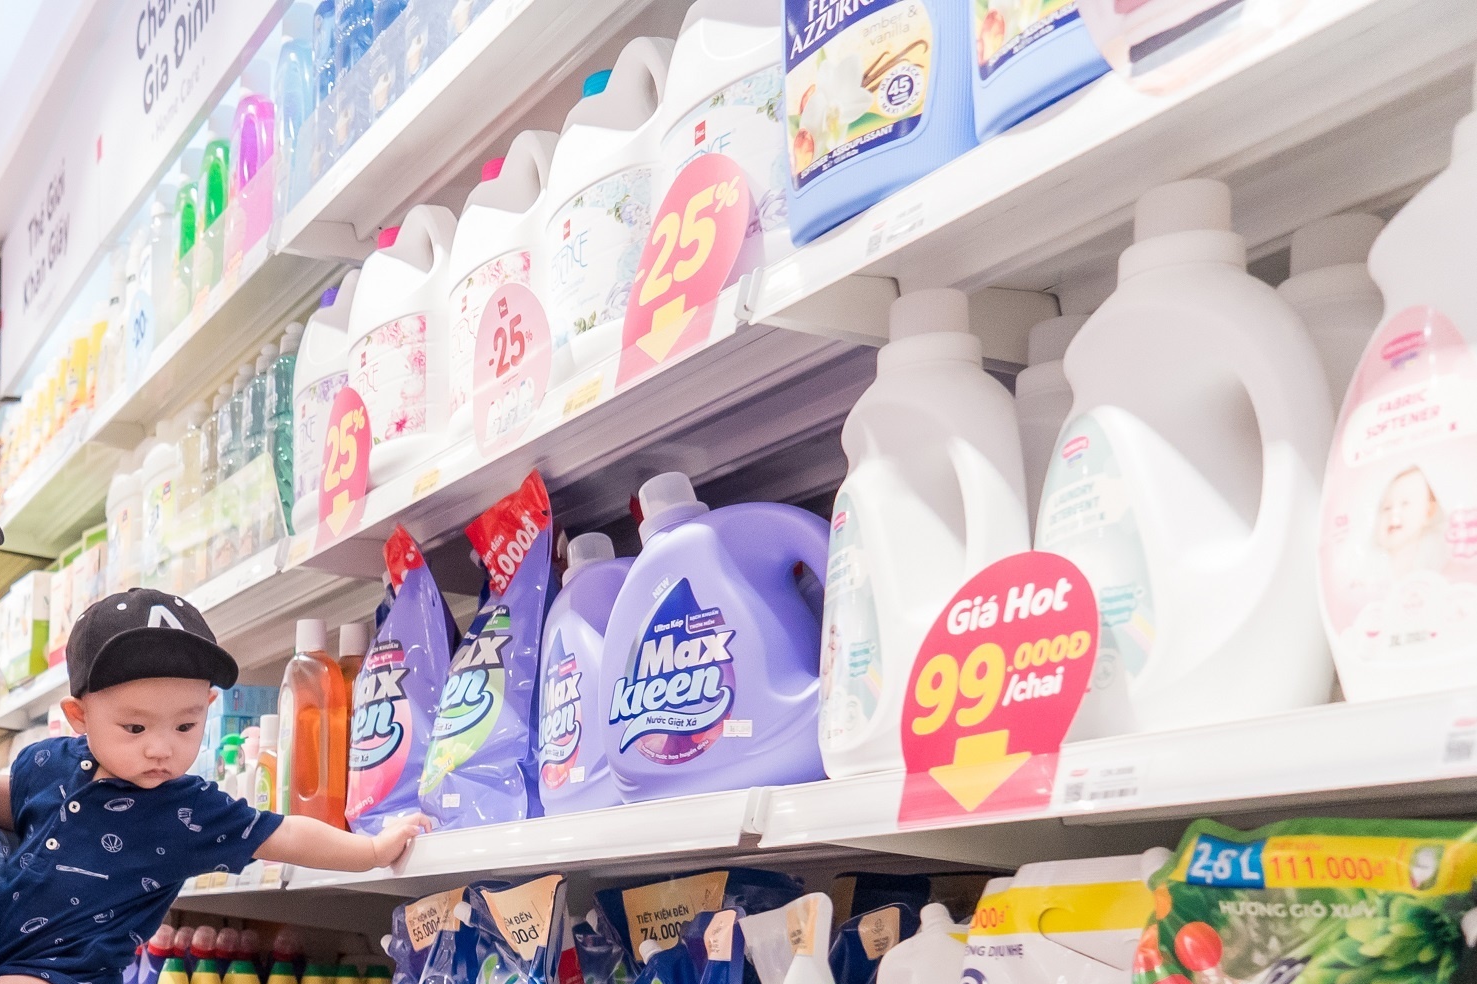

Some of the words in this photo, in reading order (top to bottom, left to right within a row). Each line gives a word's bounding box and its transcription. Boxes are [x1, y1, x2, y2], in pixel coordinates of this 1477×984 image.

[144, 53, 169, 115] Gia
[888, 77, 912, 96] 45
[634, 176, 741, 307] -25%
[488, 313, 534, 379] -25%
[946, 595, 999, 635] Giá
[1003, 577, 1073, 623] Hot
[636, 629, 736, 681] Max
[543, 672, 582, 713] Max
[1001, 665, 1065, 707] /chai
